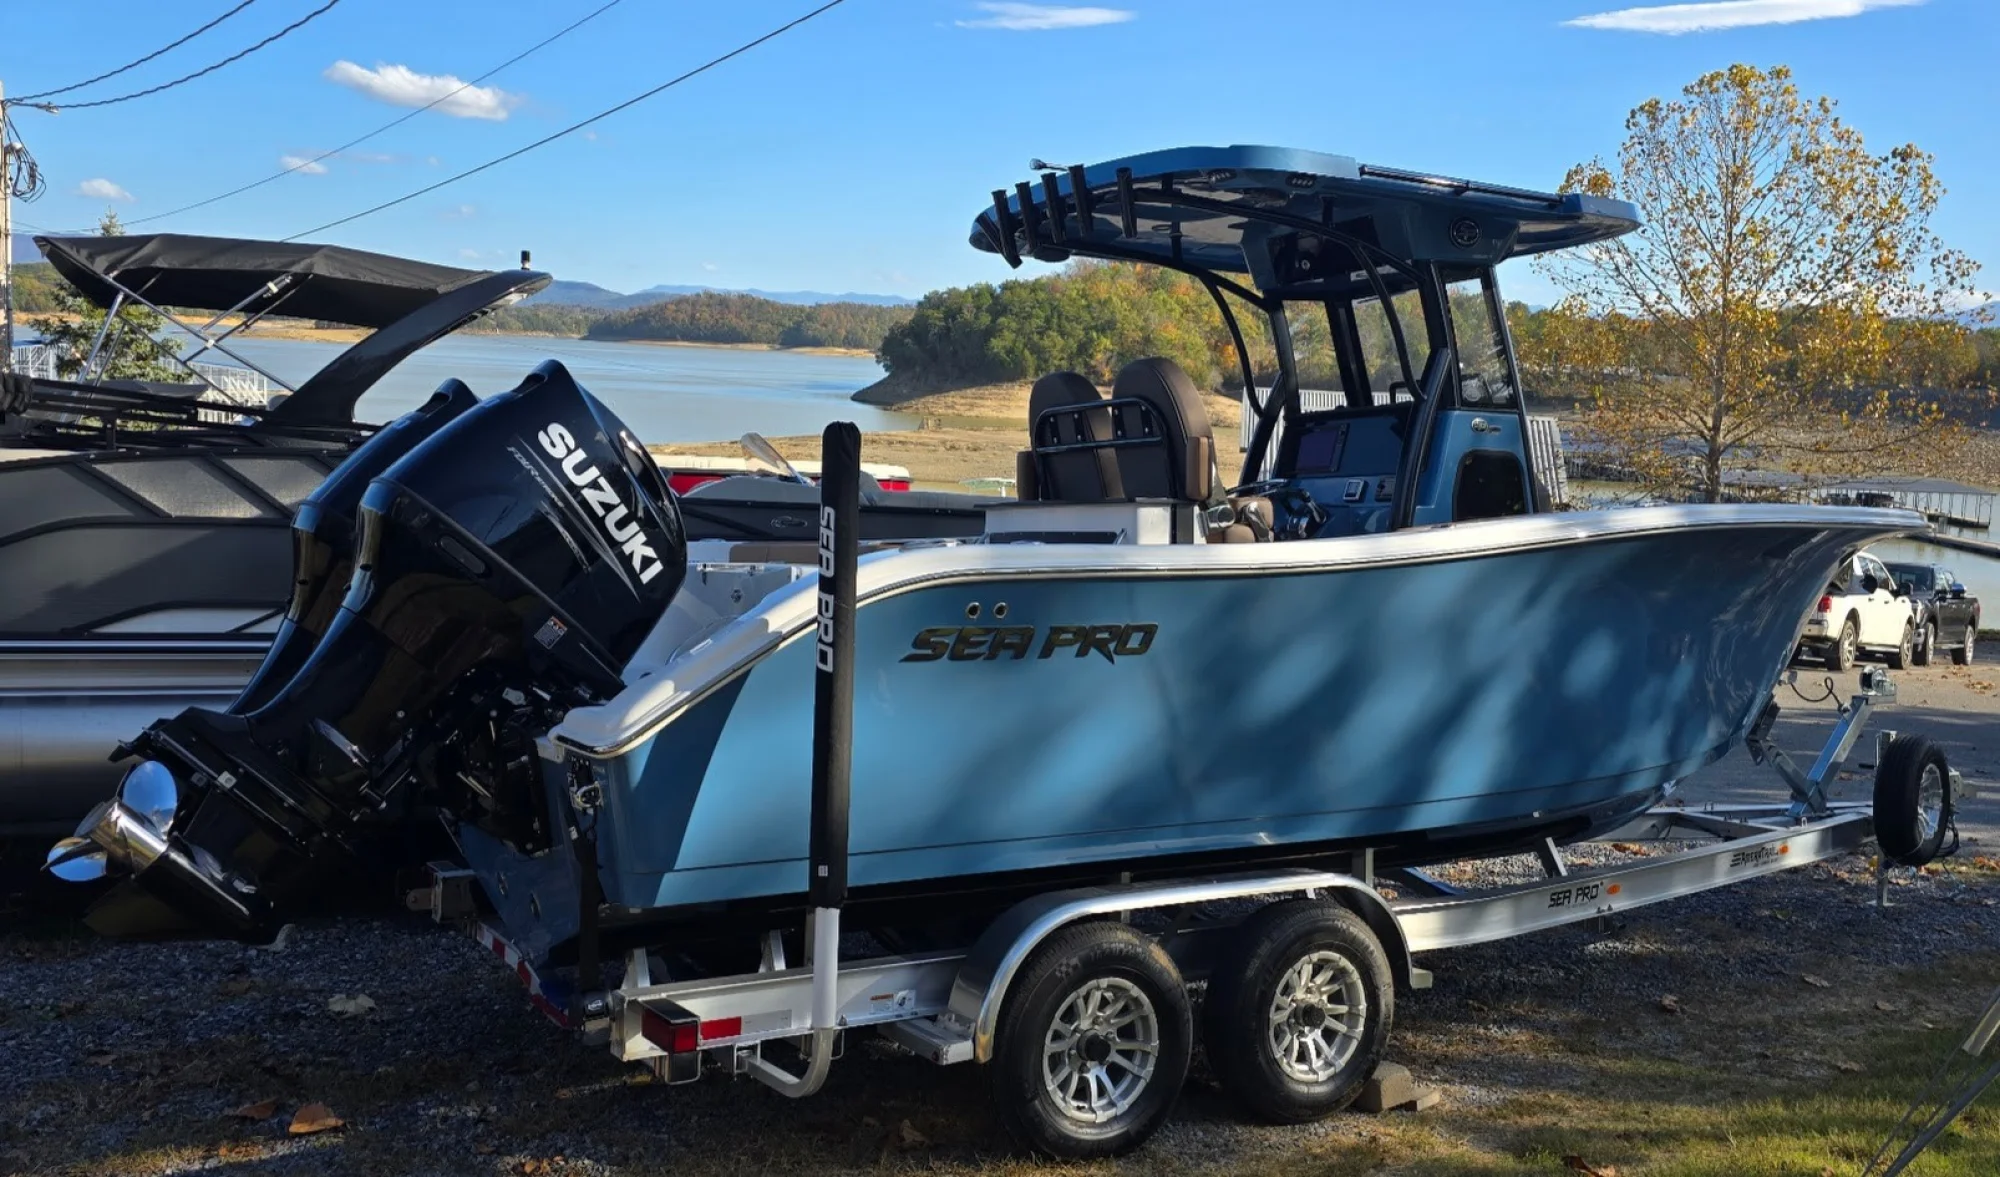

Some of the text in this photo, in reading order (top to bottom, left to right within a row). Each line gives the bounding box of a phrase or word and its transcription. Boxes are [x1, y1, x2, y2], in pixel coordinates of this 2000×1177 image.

[538, 422, 664, 585] SUZUKI
[816, 506, 836, 673] SEA PRO
[898, 622, 1159, 665] SEA PRO
[1548, 884, 1600, 908] SEA PRO
